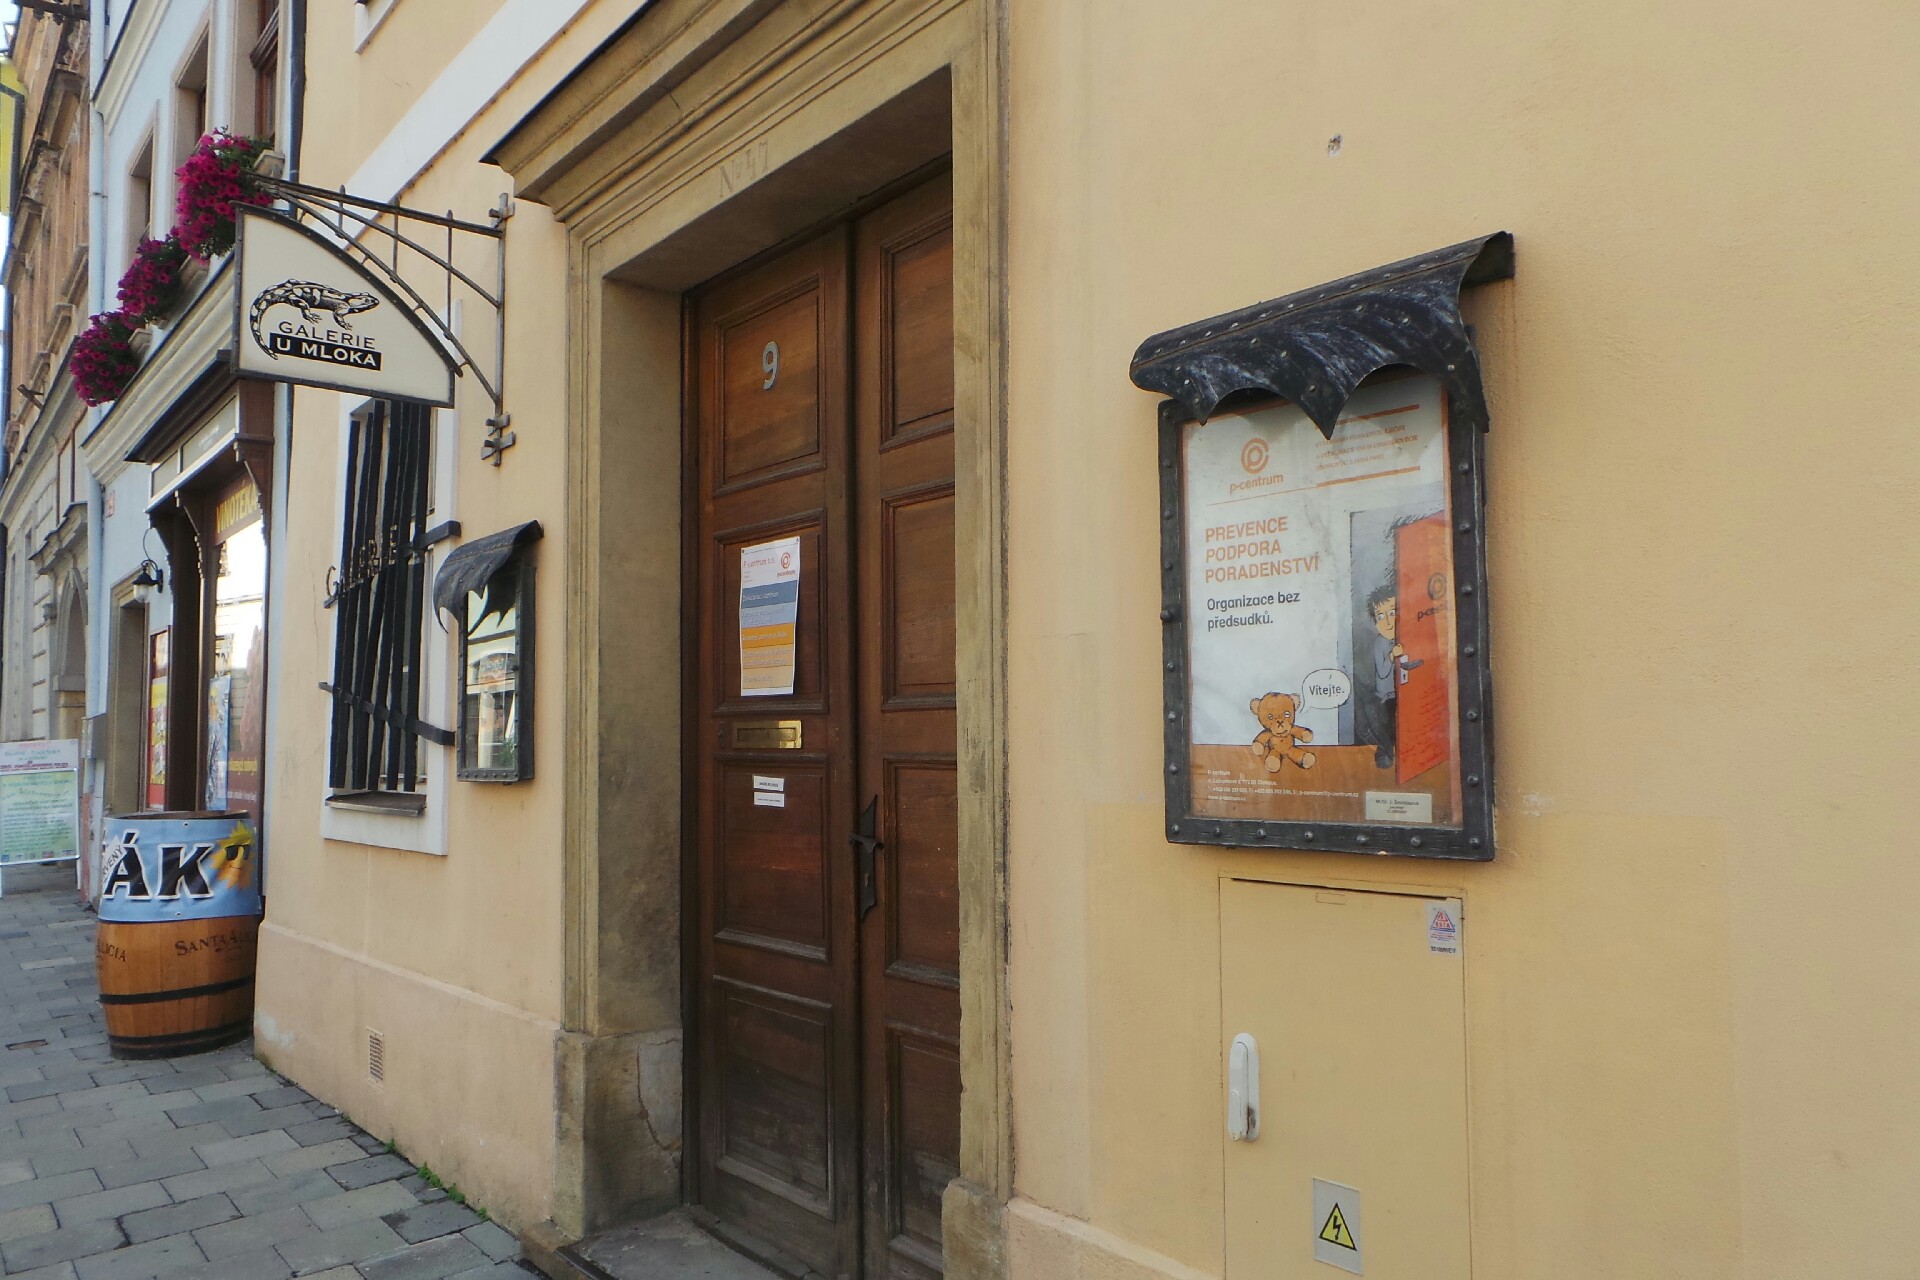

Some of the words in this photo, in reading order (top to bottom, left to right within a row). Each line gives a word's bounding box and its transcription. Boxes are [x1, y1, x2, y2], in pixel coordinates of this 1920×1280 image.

[279, 321, 376, 350] GALERIE
[276, 337, 291, 351] U
[301, 341, 377, 367] MLOKA
[762, 341, 778, 390] 9
[1229, 474, 1284, 496] p-centrum
[1205, 516, 1288, 542] PREVENCE
[1205, 540, 1282, 564] PODPORA
[1205, 552, 1319, 584] PORADENSTVÍ
[1207, 593, 1274, 612] Organizace
[1277, 591, 1300, 604] bez
[1207, 610, 1274, 632] předsudků.
[101, 828, 215, 900] ÁK
